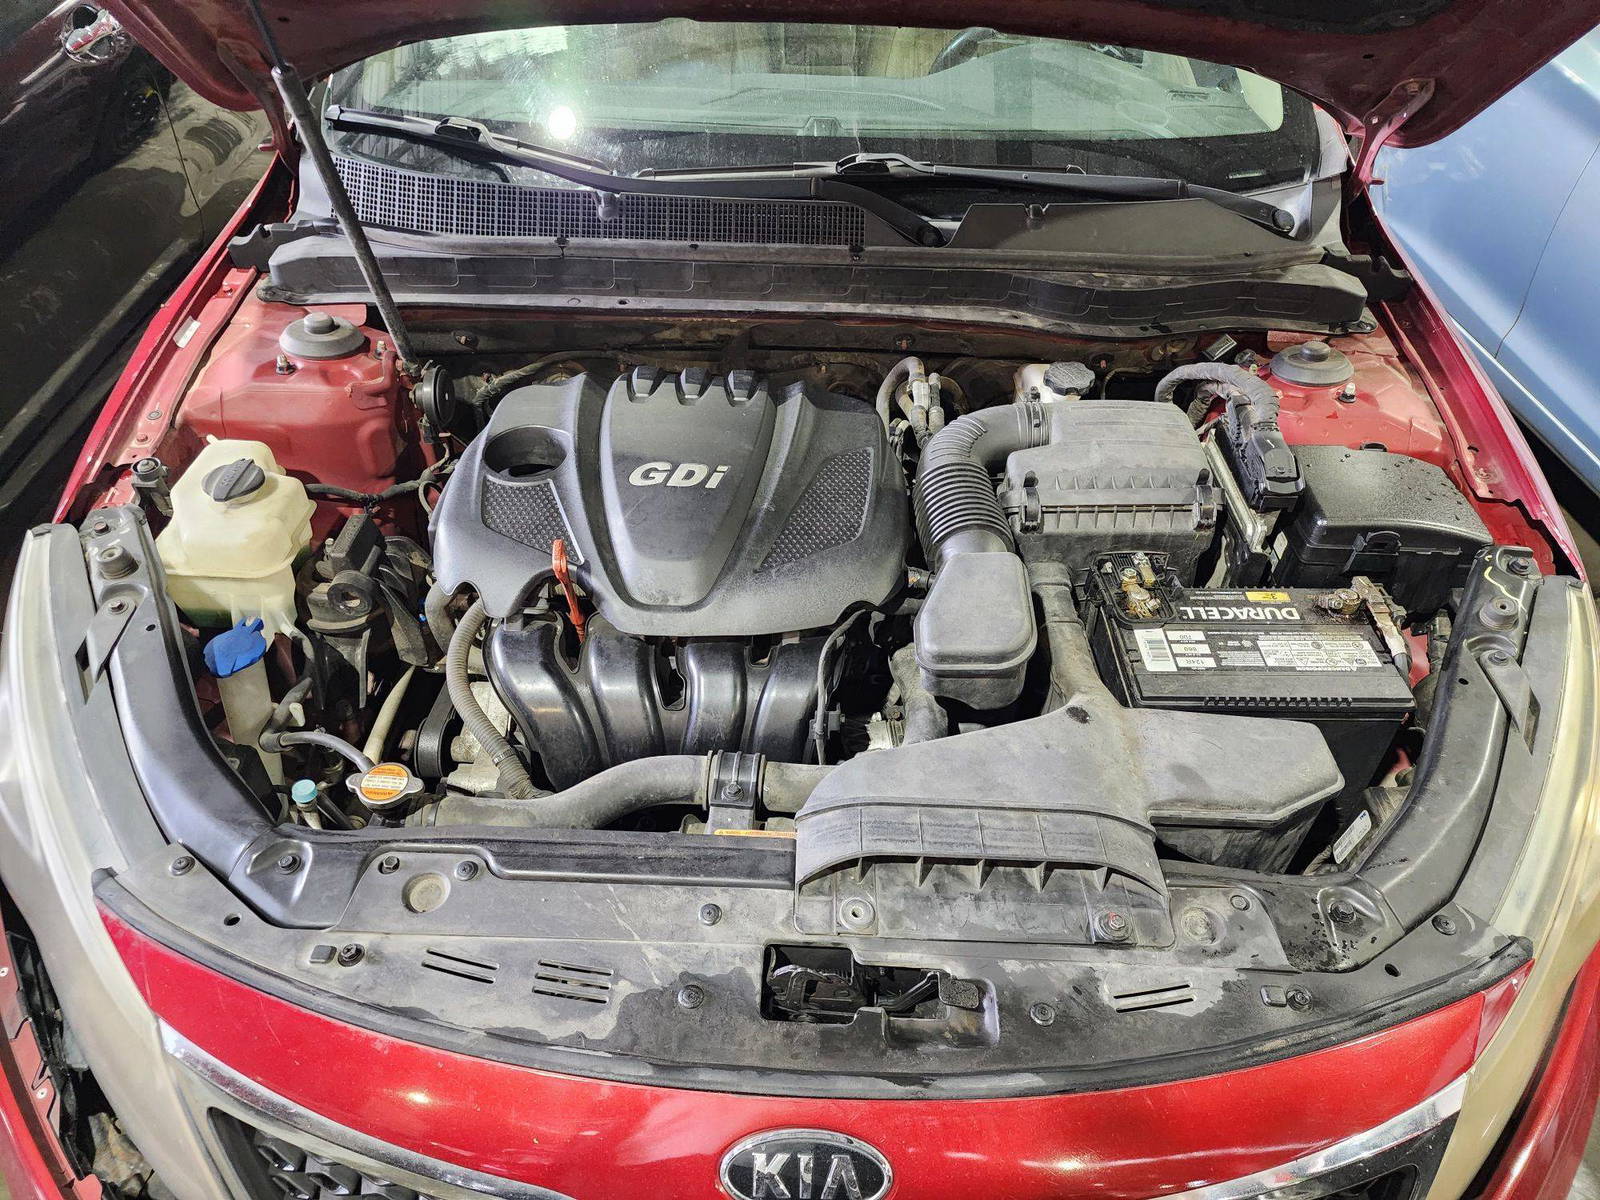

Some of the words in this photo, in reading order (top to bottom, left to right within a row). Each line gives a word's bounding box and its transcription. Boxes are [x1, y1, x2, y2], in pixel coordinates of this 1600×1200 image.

[628, 461, 730, 489] GDi
[1180, 606, 1301, 620] DURACELL
[752, 1152, 863, 1200] KIA
